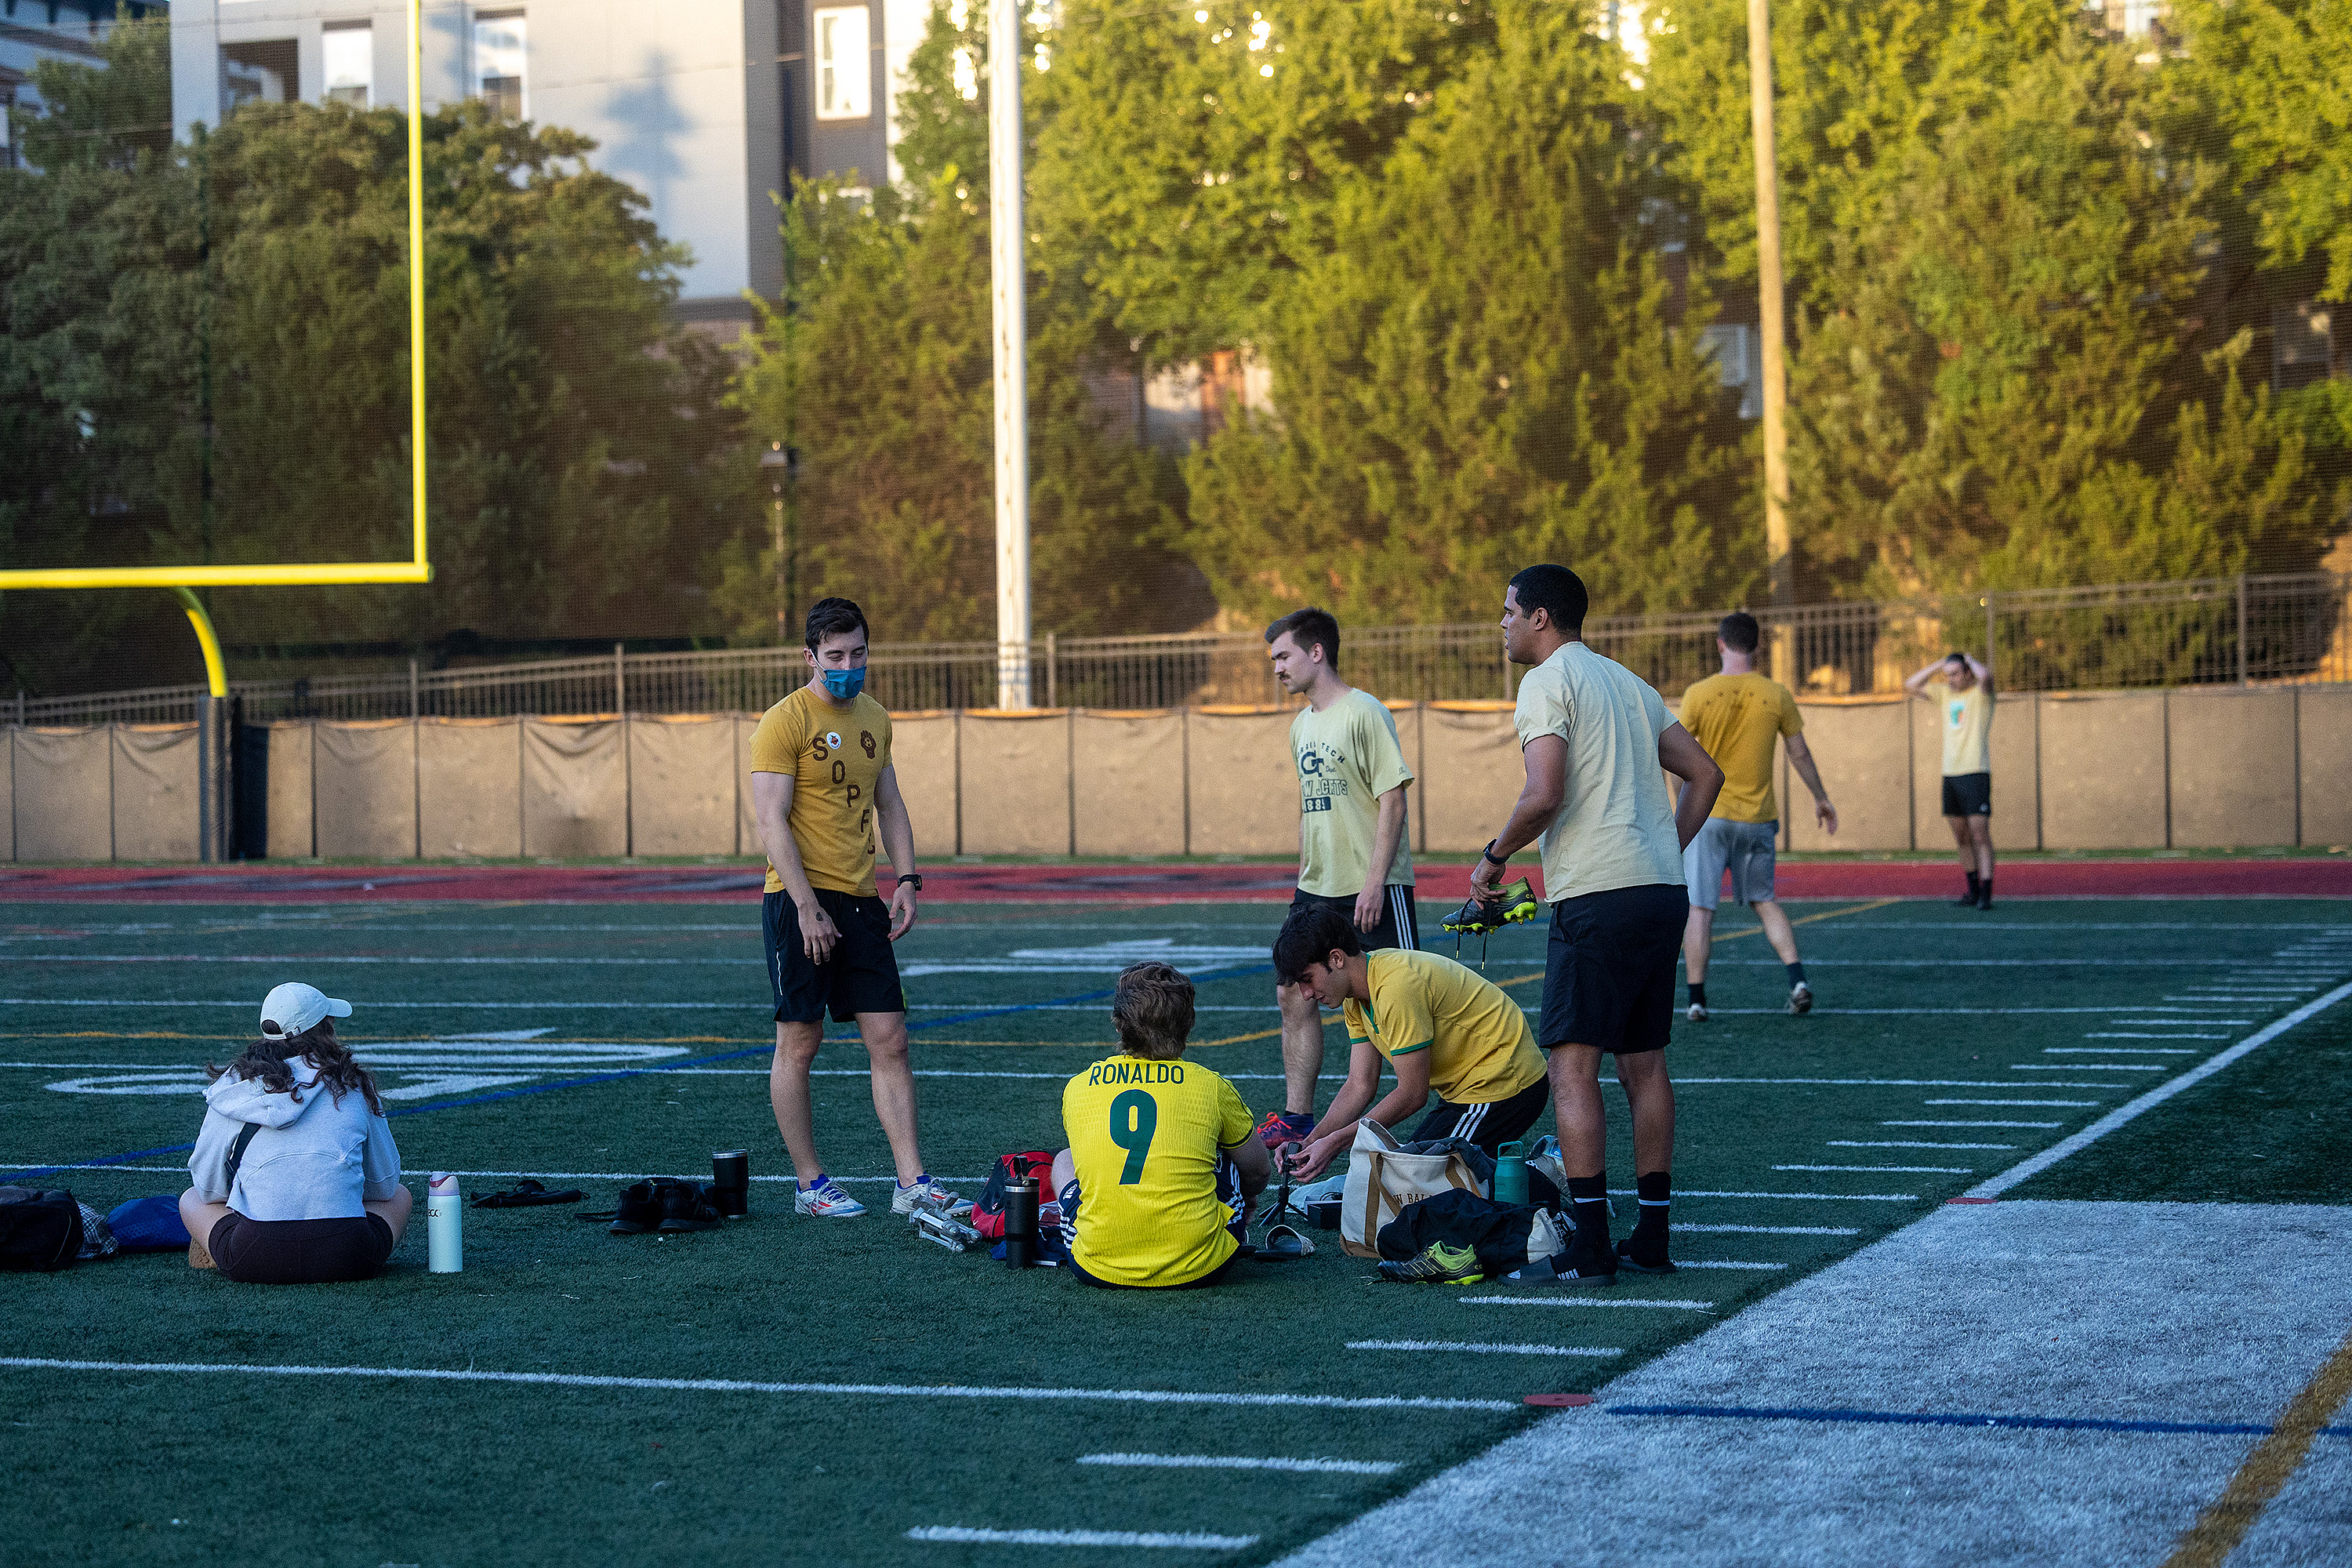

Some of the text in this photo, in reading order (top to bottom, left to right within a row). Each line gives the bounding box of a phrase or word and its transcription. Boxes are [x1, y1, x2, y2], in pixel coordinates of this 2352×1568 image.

[1321, 742, 1345, 764] TECH
[1088, 1062, 1185, 1087] RONALDO
[1109, 1088, 1158, 1185] 9
